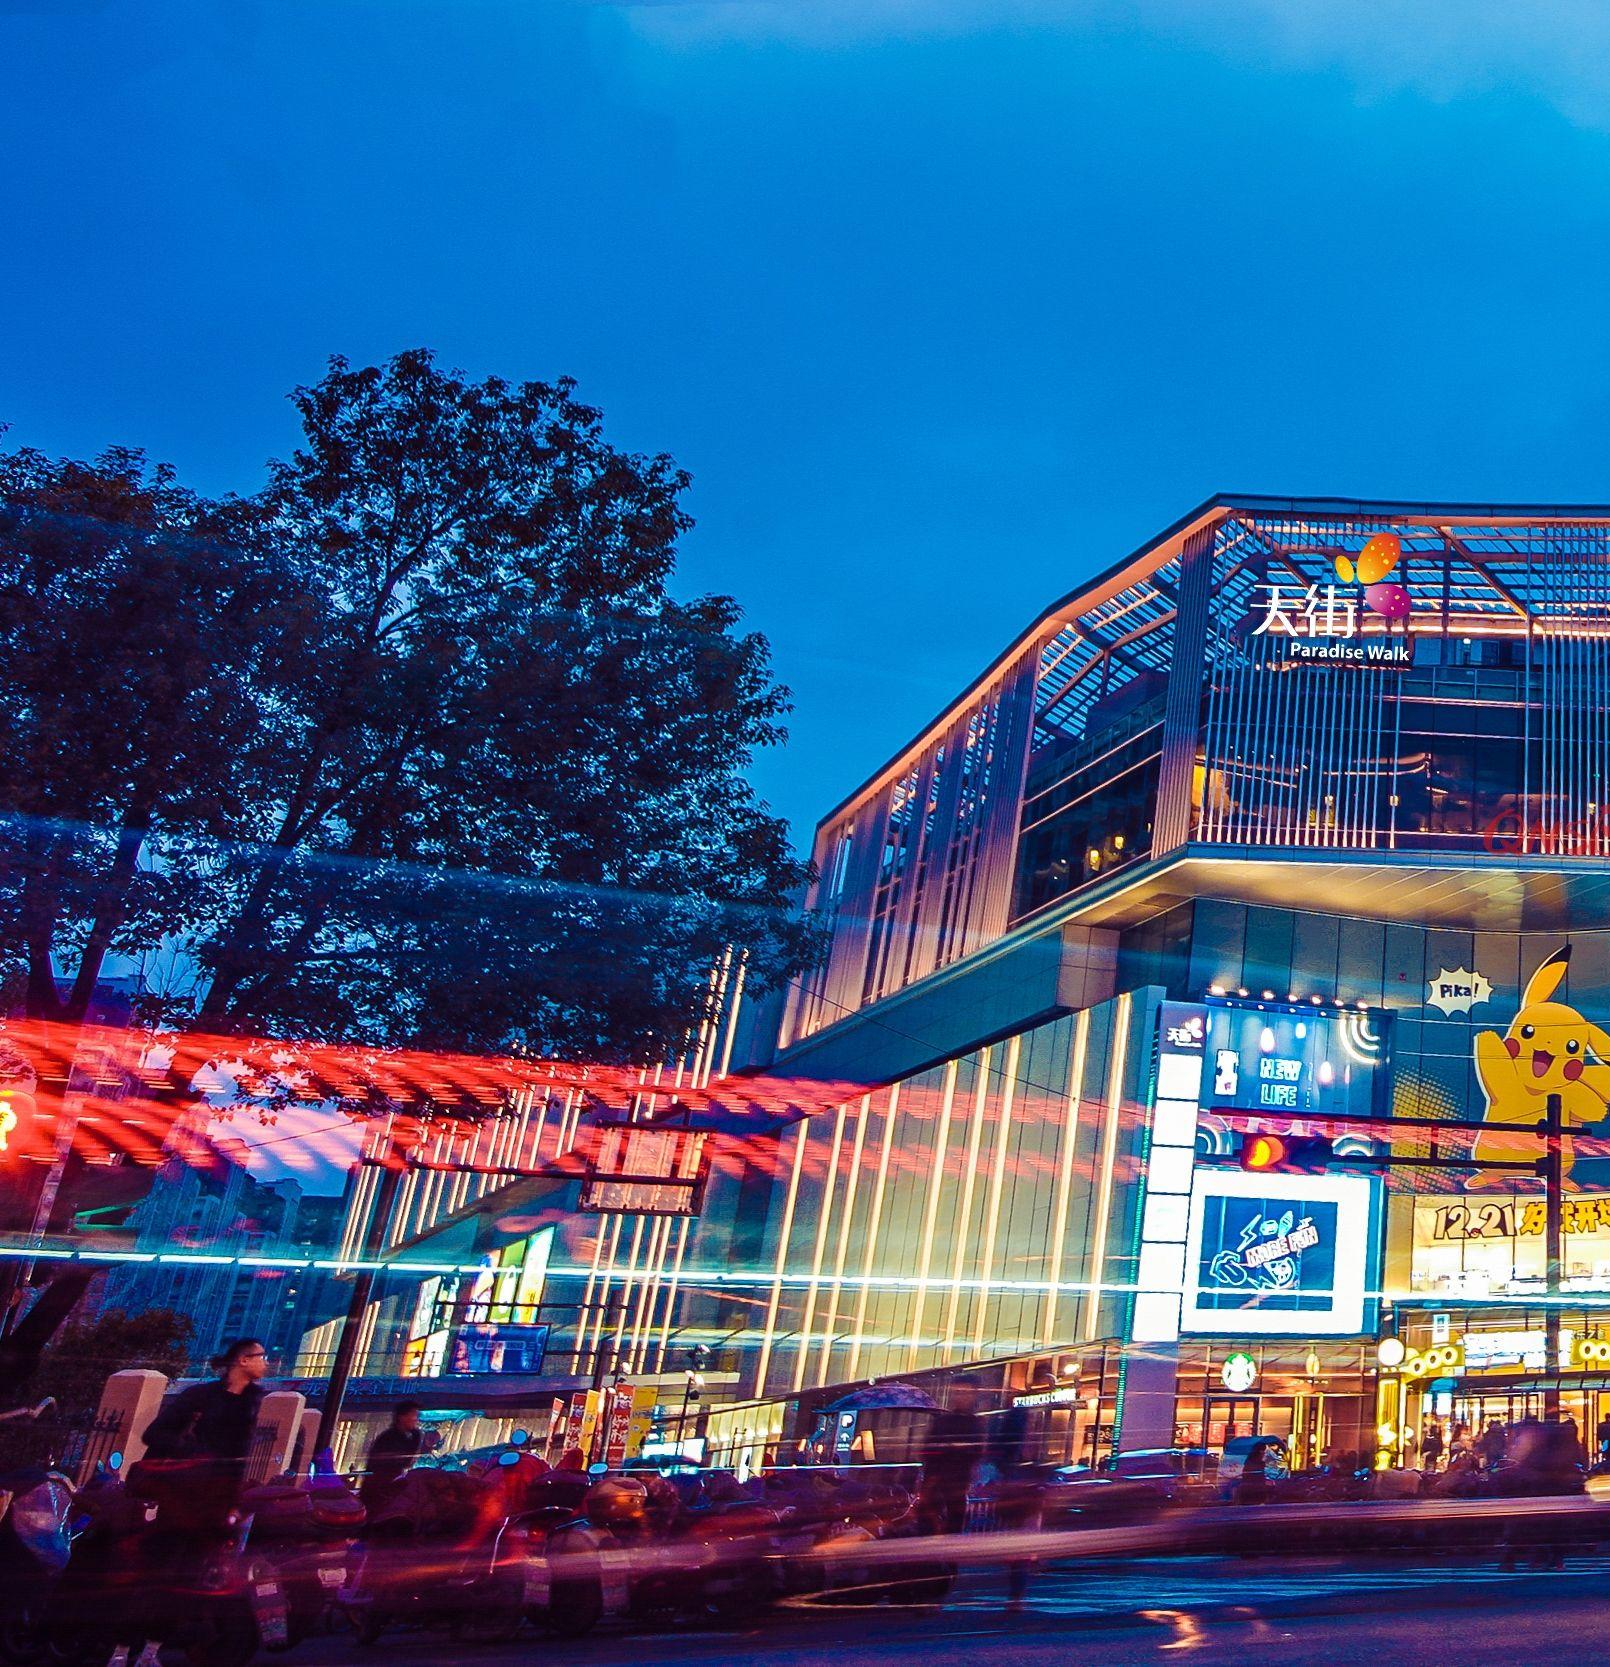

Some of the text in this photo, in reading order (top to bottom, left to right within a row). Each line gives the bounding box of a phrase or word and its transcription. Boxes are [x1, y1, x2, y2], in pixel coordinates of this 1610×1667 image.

[1250, 584, 1359, 639] 天街
[1290, 642, 1410, 661] Paradise Walk
[1440, 982, 1479, 998] Pika!
[1260, 1057, 1302, 1081] NEW
[1261, 1084, 1298, 1106] LIFE
[1245, 1237, 1291, 1268] MORE
